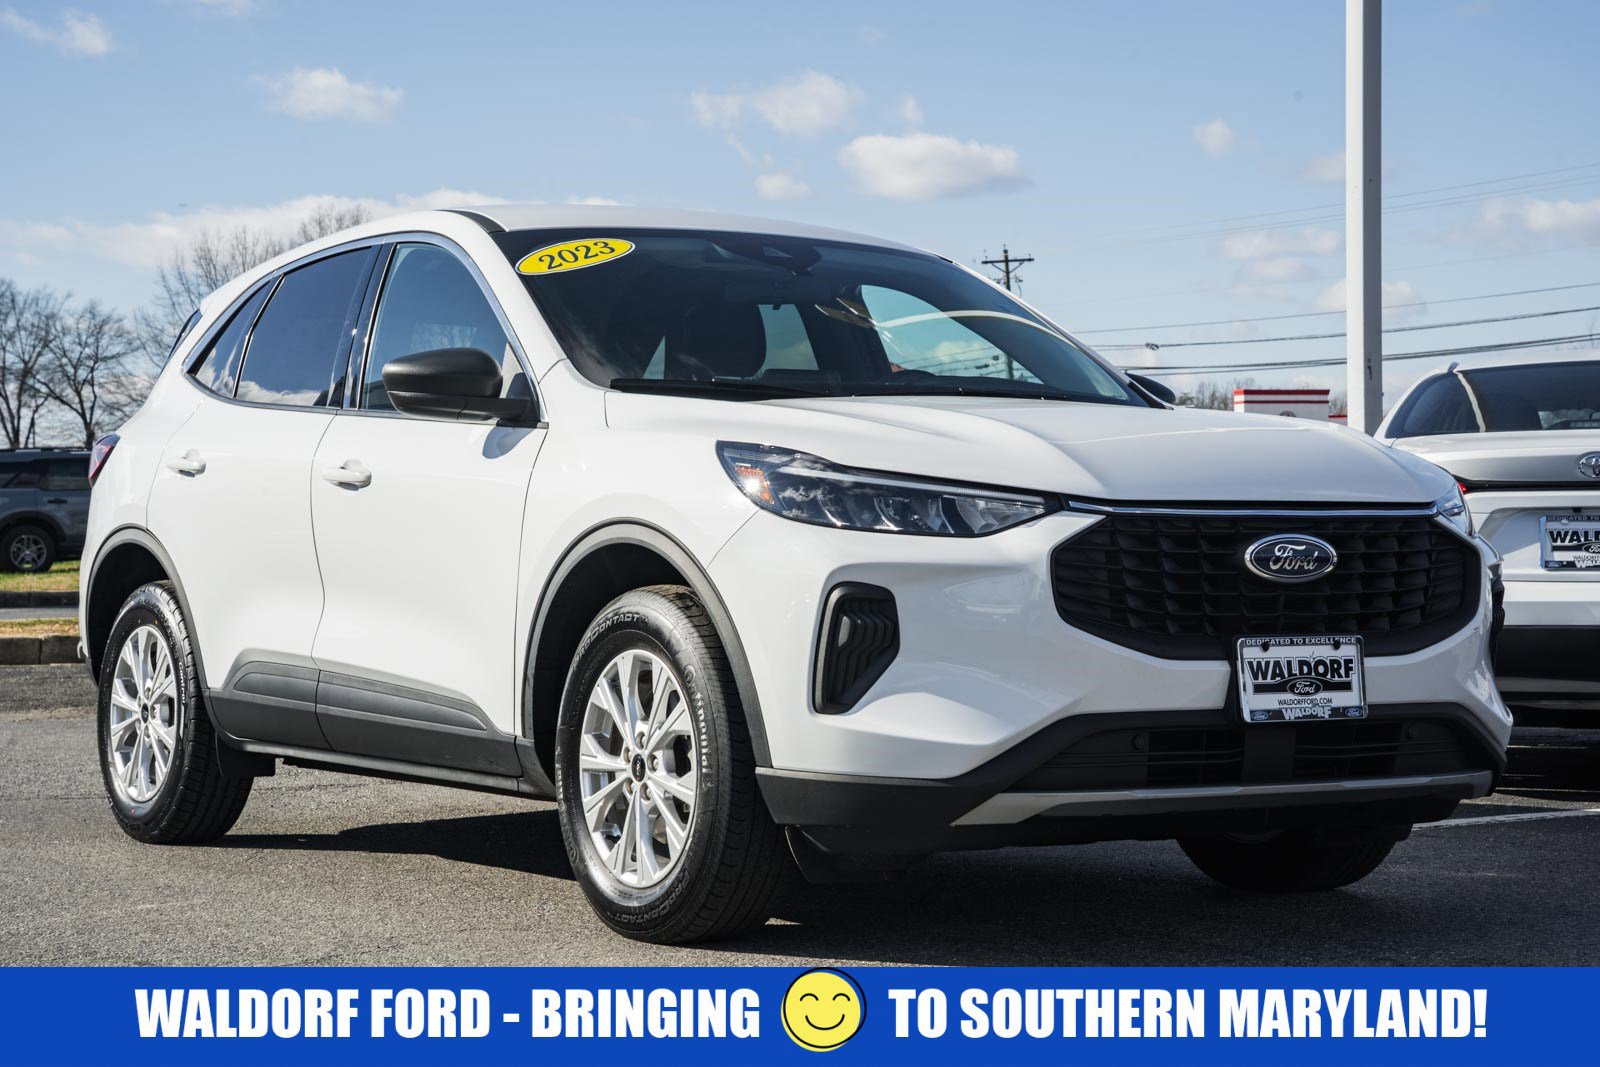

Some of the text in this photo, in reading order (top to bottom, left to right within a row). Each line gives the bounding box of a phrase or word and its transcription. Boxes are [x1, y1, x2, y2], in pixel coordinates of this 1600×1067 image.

[538, 241, 616, 270] 2023
[1269, 543, 1319, 571] Ford
[1246, 658, 1355, 681] WALDORF
[1294, 681, 1316, 694] Ford
[1277, 698, 1333, 707] WALDORFFORD.COM
[1281, 706, 1331, 720] WALDORF
